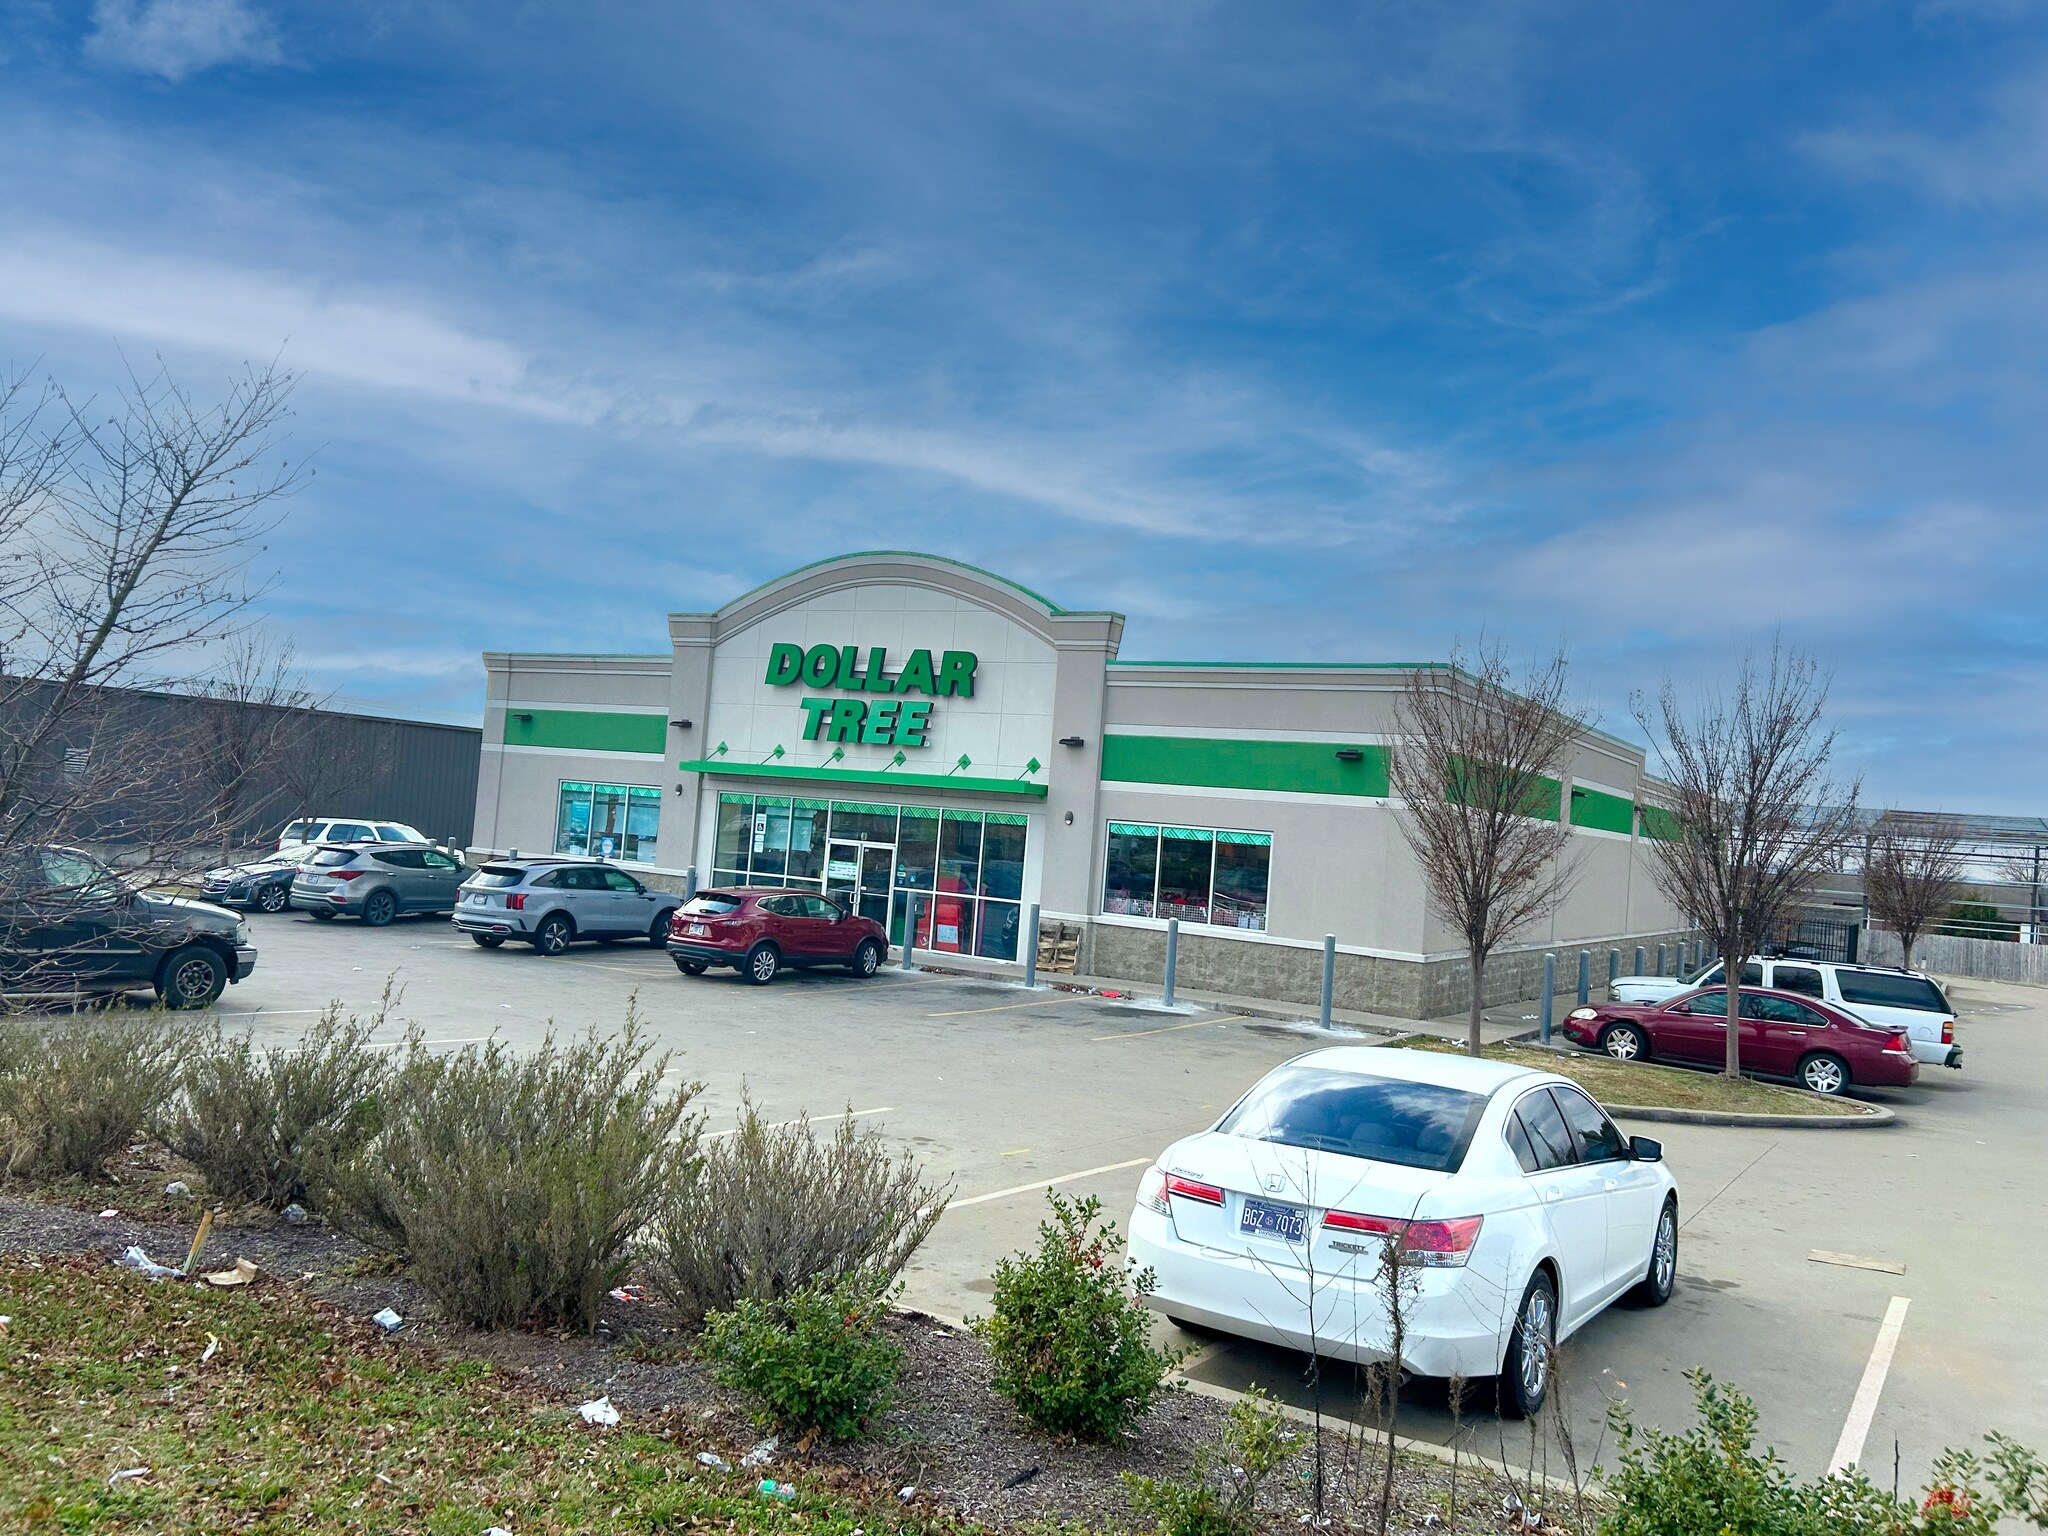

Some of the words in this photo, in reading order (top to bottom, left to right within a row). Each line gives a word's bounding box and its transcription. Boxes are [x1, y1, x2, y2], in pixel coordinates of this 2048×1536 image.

[765, 643, 978, 697] DOLLAR
[800, 697, 935, 747] TREE
[1243, 1208, 1265, 1228] BGZ
[1275, 1213, 1303, 1235] 7073
